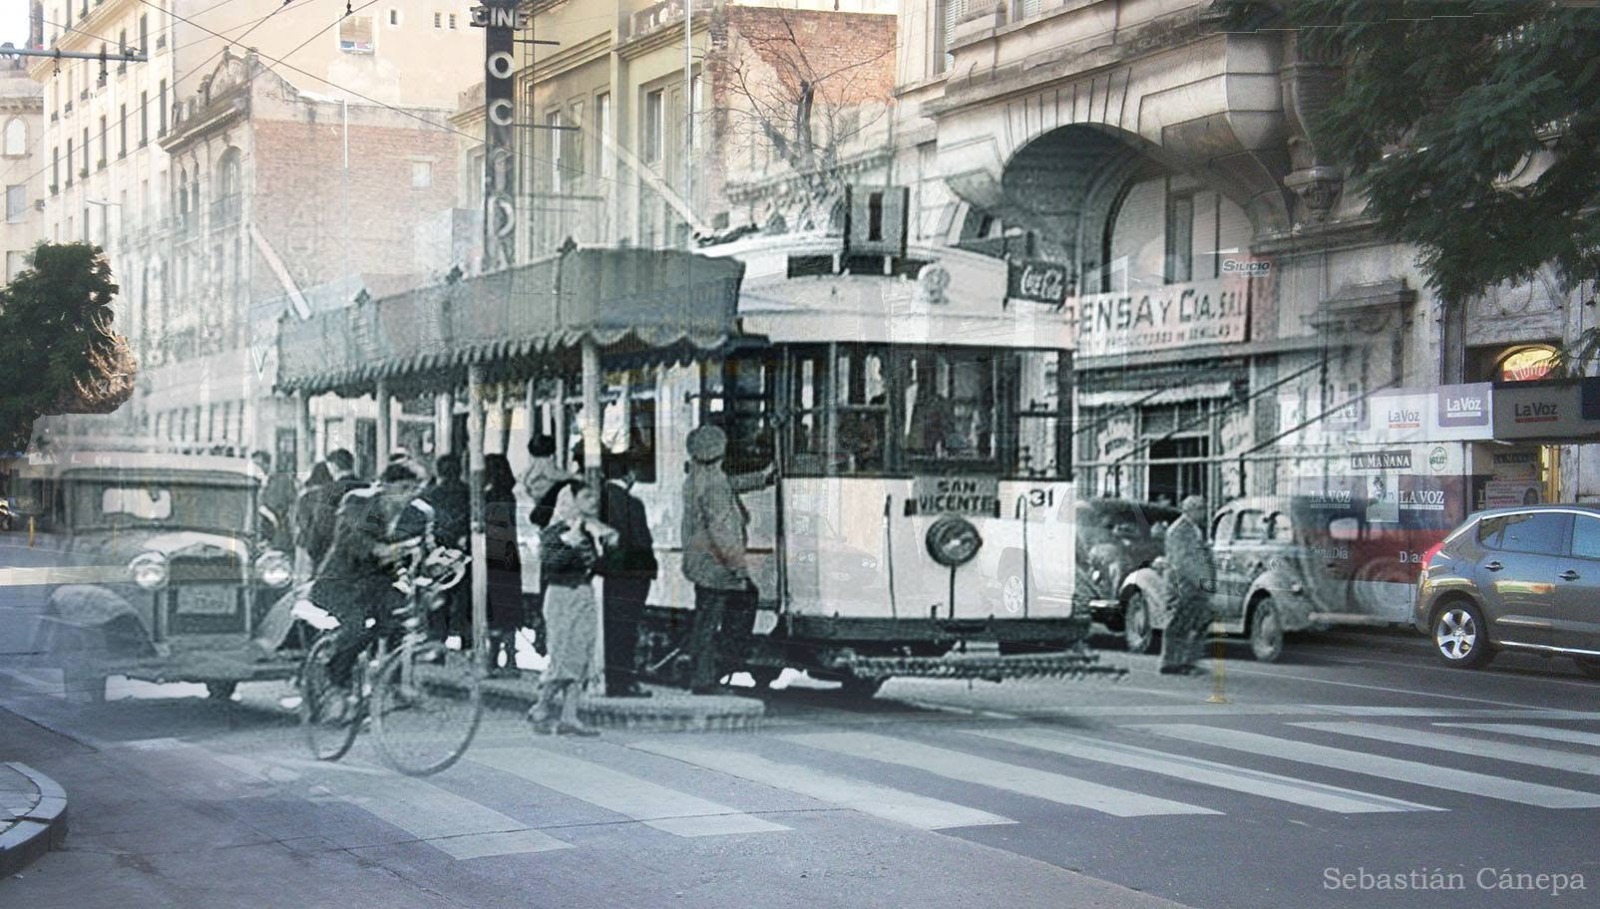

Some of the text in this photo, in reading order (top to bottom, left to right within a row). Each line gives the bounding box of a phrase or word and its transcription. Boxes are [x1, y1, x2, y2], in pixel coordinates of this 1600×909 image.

[470, 6, 528, 28] CINE
[1352, 451, 1411, 468] LA MAÑANA
[938, 480, 976, 493] SAN
[919, 495, 994, 512] VICENTE
[1030, 489, 1054, 507] 31
[1328, 490, 1350, 503] VOZ
[1400, 491, 1416, 504] LA
[1421, 491, 1445, 504] VOZ
